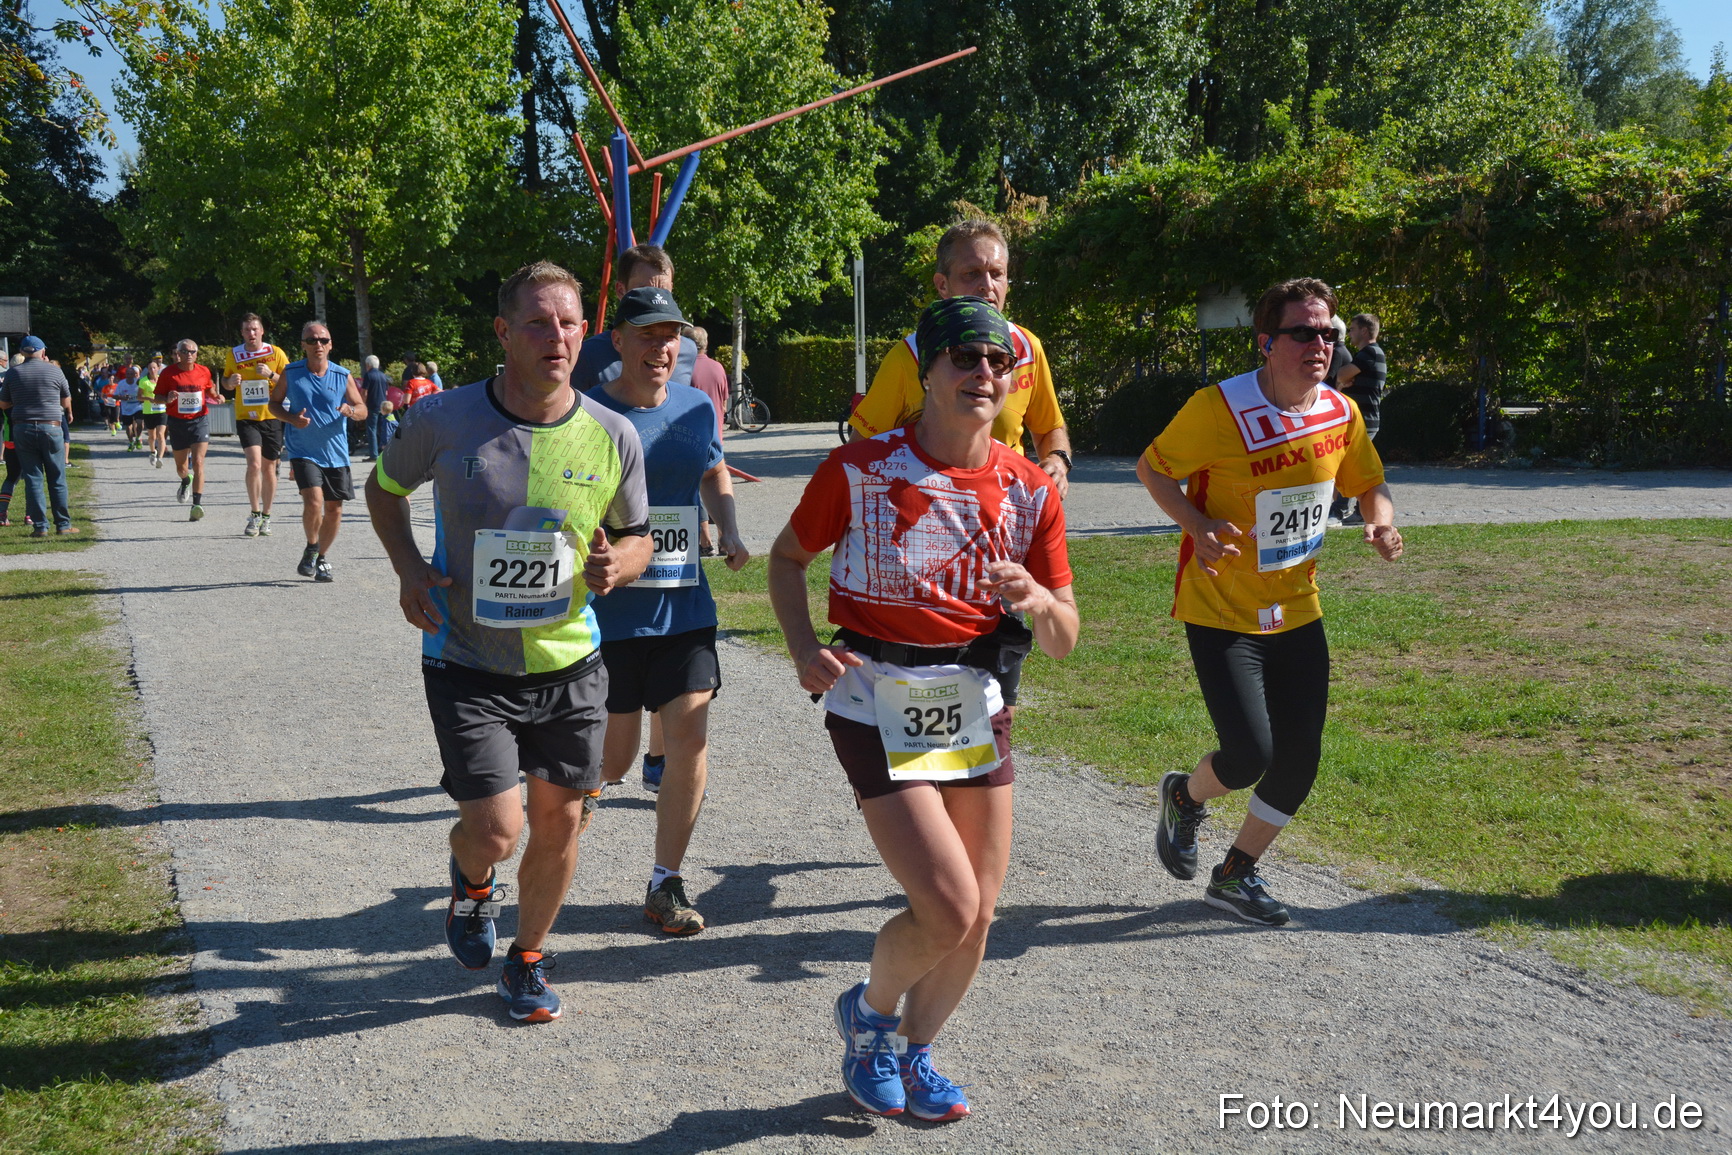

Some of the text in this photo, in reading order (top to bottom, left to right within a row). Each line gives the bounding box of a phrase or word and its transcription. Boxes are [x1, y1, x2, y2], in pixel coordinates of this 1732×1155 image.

[245, 387, 264, 396] 2411
[1250, 432, 1351, 477] MAX BÖGL
[925, 478, 952, 491] 10.54
[1282, 491, 1316, 504] BOCK
[1270, 504, 1323, 536] 2419
[506, 540, 553, 552] BOCK
[925, 541, 953, 551] 26.22
[1276, 542, 1314, 560] Christoph
[489, 558, 560, 588] 2221
[643, 567, 680, 578] Michael
[495, 592, 549, 600] PARTL Neumarkt
[505, 605, 546, 618] Rainer
[909, 683, 959, 699] BOCK
[903, 703, 962, 737] 325
[927, 740, 959, 748] Neumarkt
